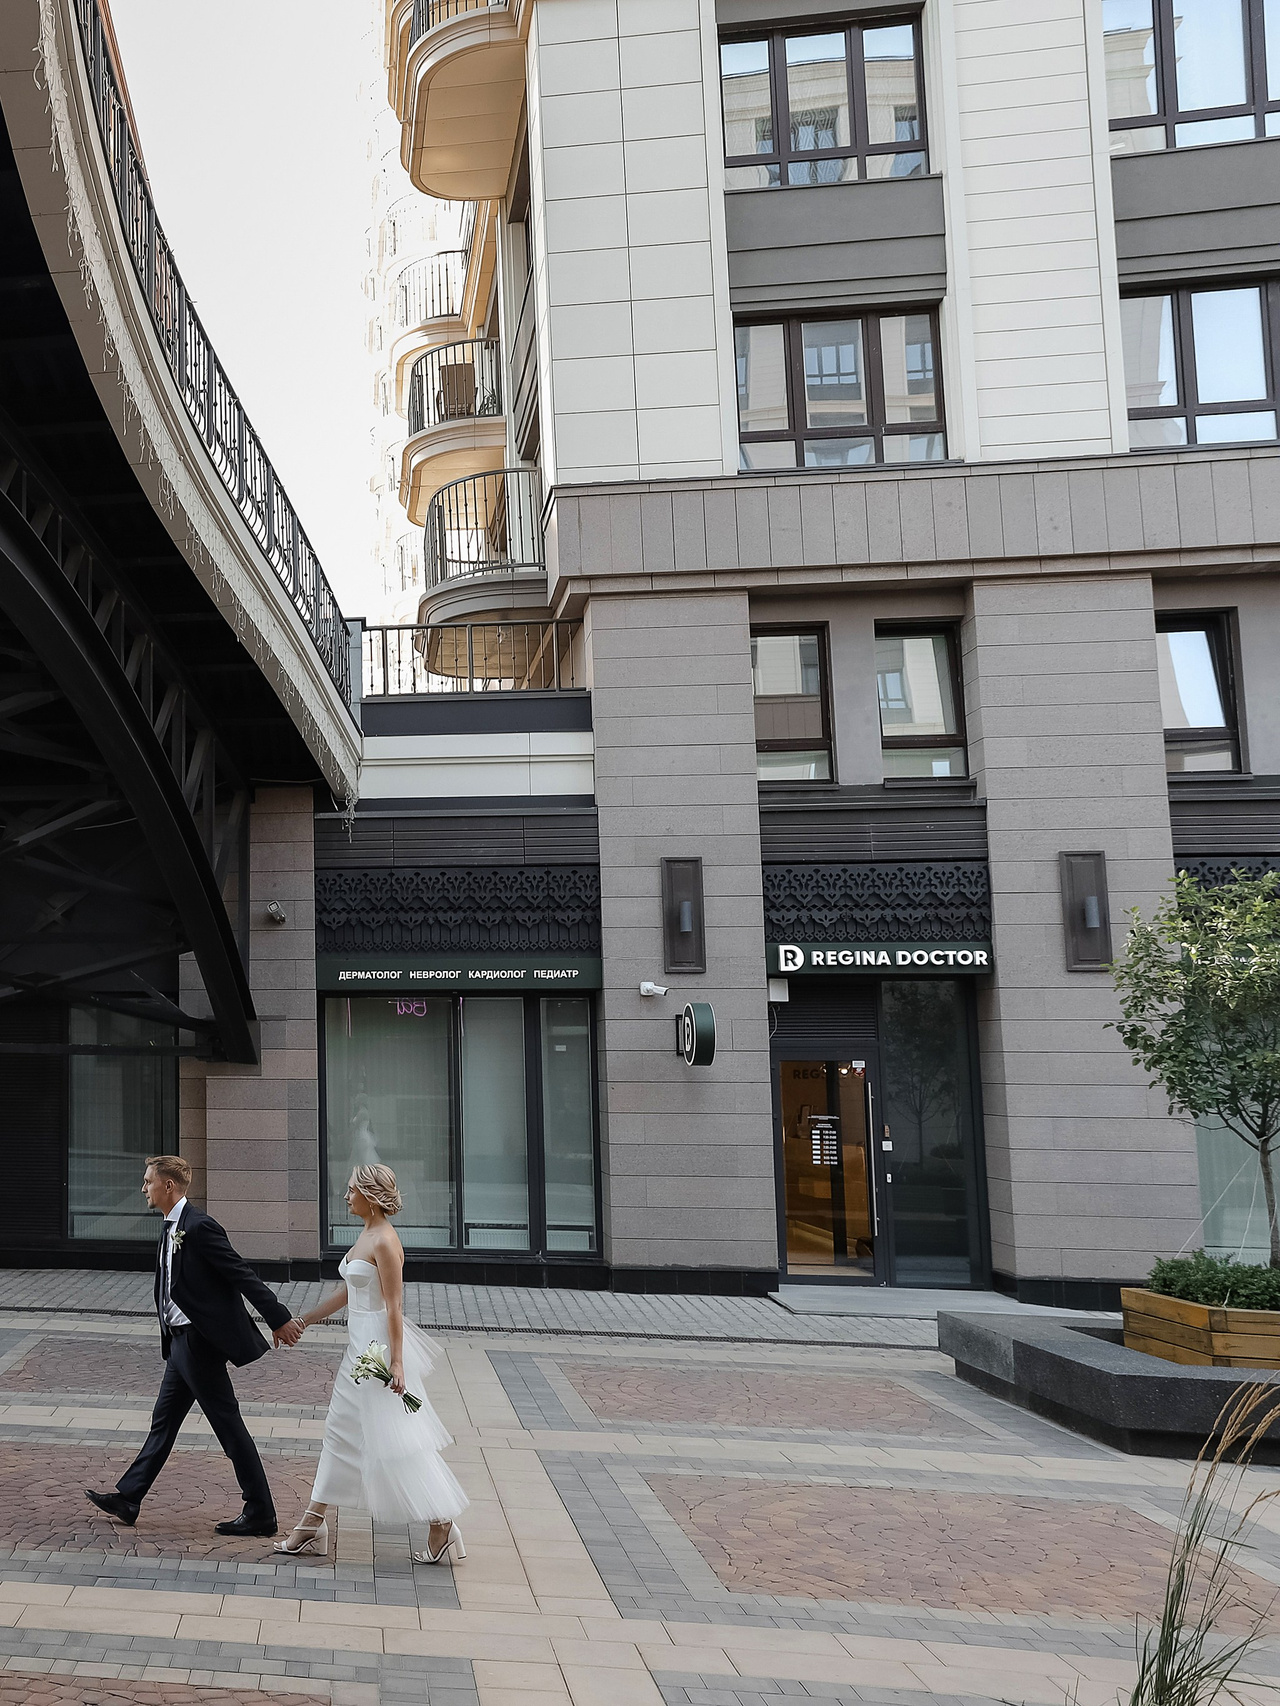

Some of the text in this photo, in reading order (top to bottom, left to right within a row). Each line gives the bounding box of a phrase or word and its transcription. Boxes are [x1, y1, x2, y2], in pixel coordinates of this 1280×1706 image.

[811, 950, 891, 966] REGINA
[896, 950, 988, 966] DOCTOR
[338, 969, 579, 981] ДЕРМАТОЛОГ НЕВРОЛОГ КАРДИОЛОГ ПЕДИАТР
